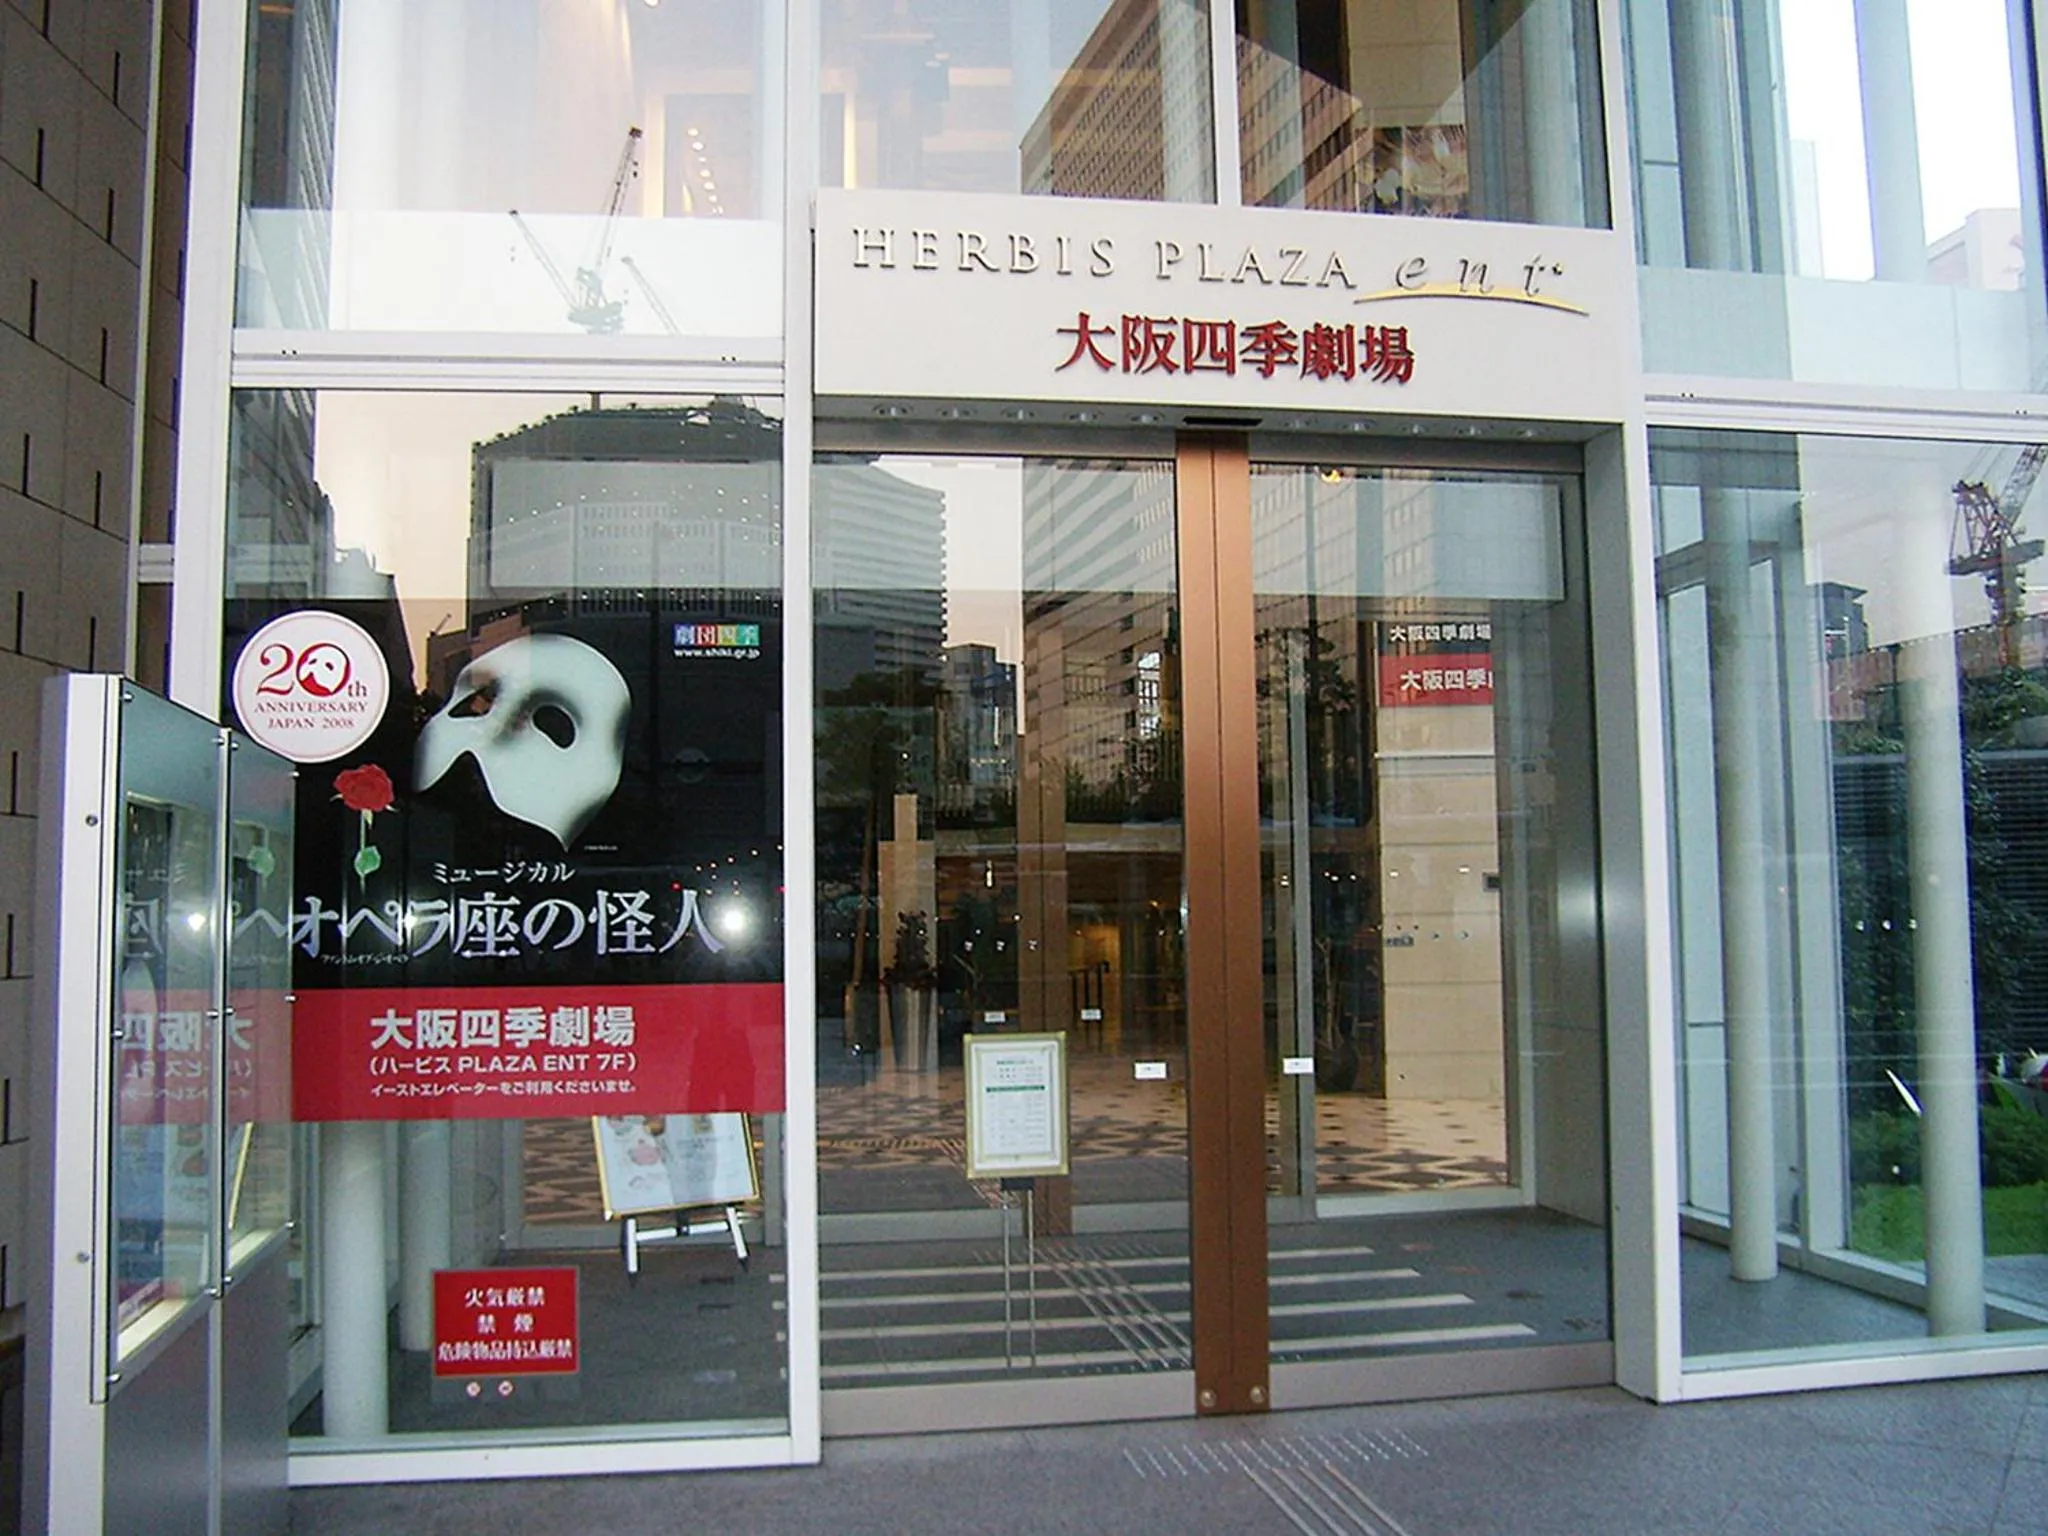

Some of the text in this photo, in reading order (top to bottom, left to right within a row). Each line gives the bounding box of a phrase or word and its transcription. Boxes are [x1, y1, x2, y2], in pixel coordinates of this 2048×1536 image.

[853, 225, 1115, 277] HERBIS
[1154, 239, 1359, 289] PLAZA
[1056, 312, 1415, 386] 大阪四季劇場
[1401, 668, 1493, 691] 大阪四季
[254, 701, 368, 713] ANNIVERSARY
[267, 717, 355, 729] JAPAN 2008
[433, 862, 576, 883] ミュージカル
[289, 888, 726, 959] オペラ座の怪人
[370, 1006, 636, 1049] 大阪四季劇場
[458, 1054, 538, 1073] PLAZA
[543, 1054, 590, 1072] ENT
[465, 1286, 546, 1308] 火気厳禁
